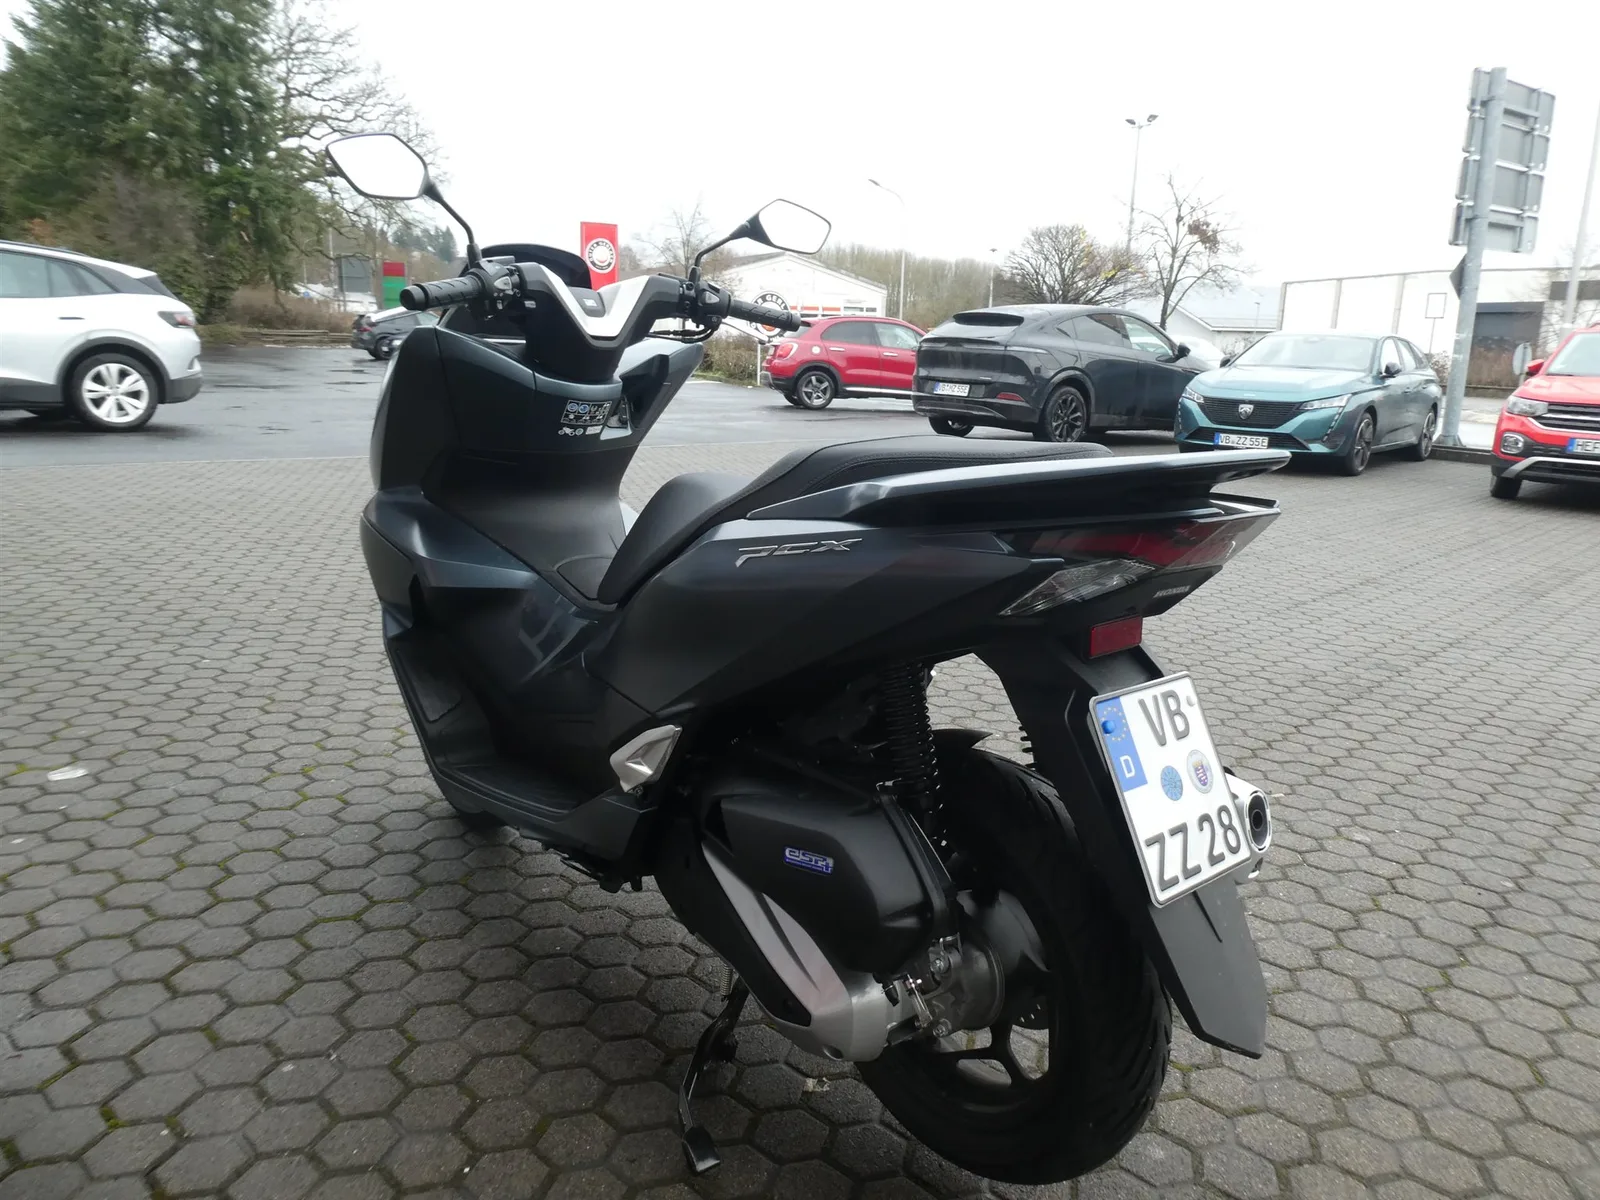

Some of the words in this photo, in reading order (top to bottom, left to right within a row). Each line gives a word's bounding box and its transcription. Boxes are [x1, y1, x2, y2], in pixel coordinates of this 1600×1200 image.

[1236, 437, 1247, 446] ZZ
[1249, 438, 1267, 447] 55E
[735, 538, 862, 568] PCX
[1138, 689, 1190, 747] VB
[1120, 755, 1136, 779] D
[1144, 822, 1202, 892] ZZ
[1198, 804, 1241, 867] 28
